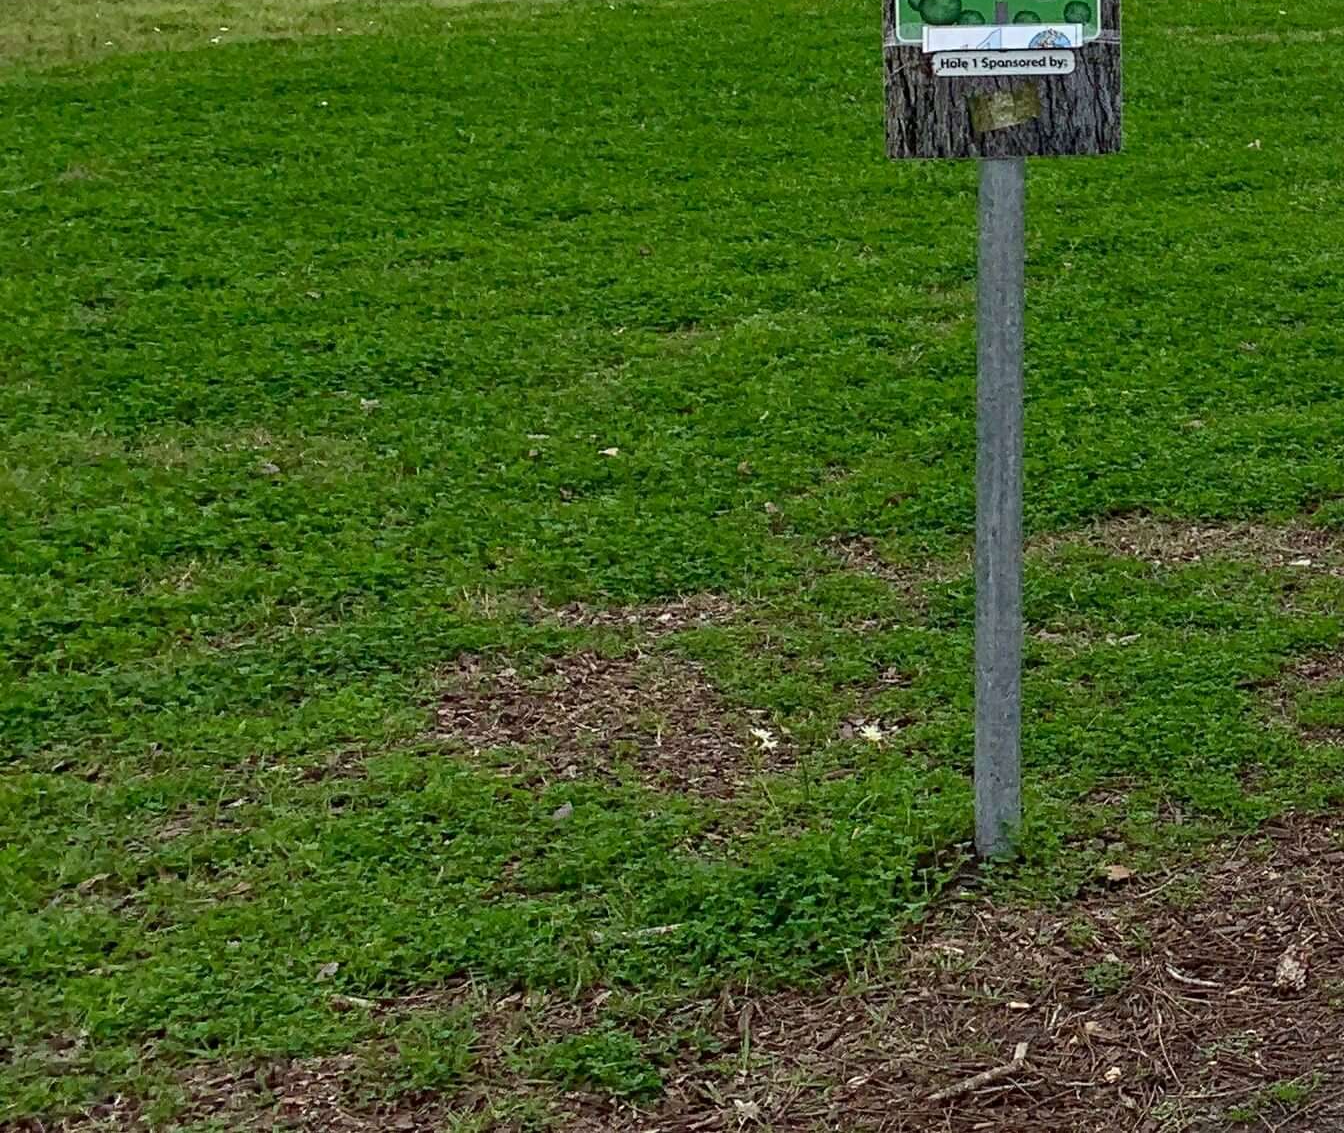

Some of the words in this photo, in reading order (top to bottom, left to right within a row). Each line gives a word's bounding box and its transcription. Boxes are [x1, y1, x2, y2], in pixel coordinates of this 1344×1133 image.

[940, 57, 969, 69] Hole
[972, 57, 978, 68] 1
[981, 56, 1047, 70] Sponsored
[1049, 56, 1068, 70] by:
